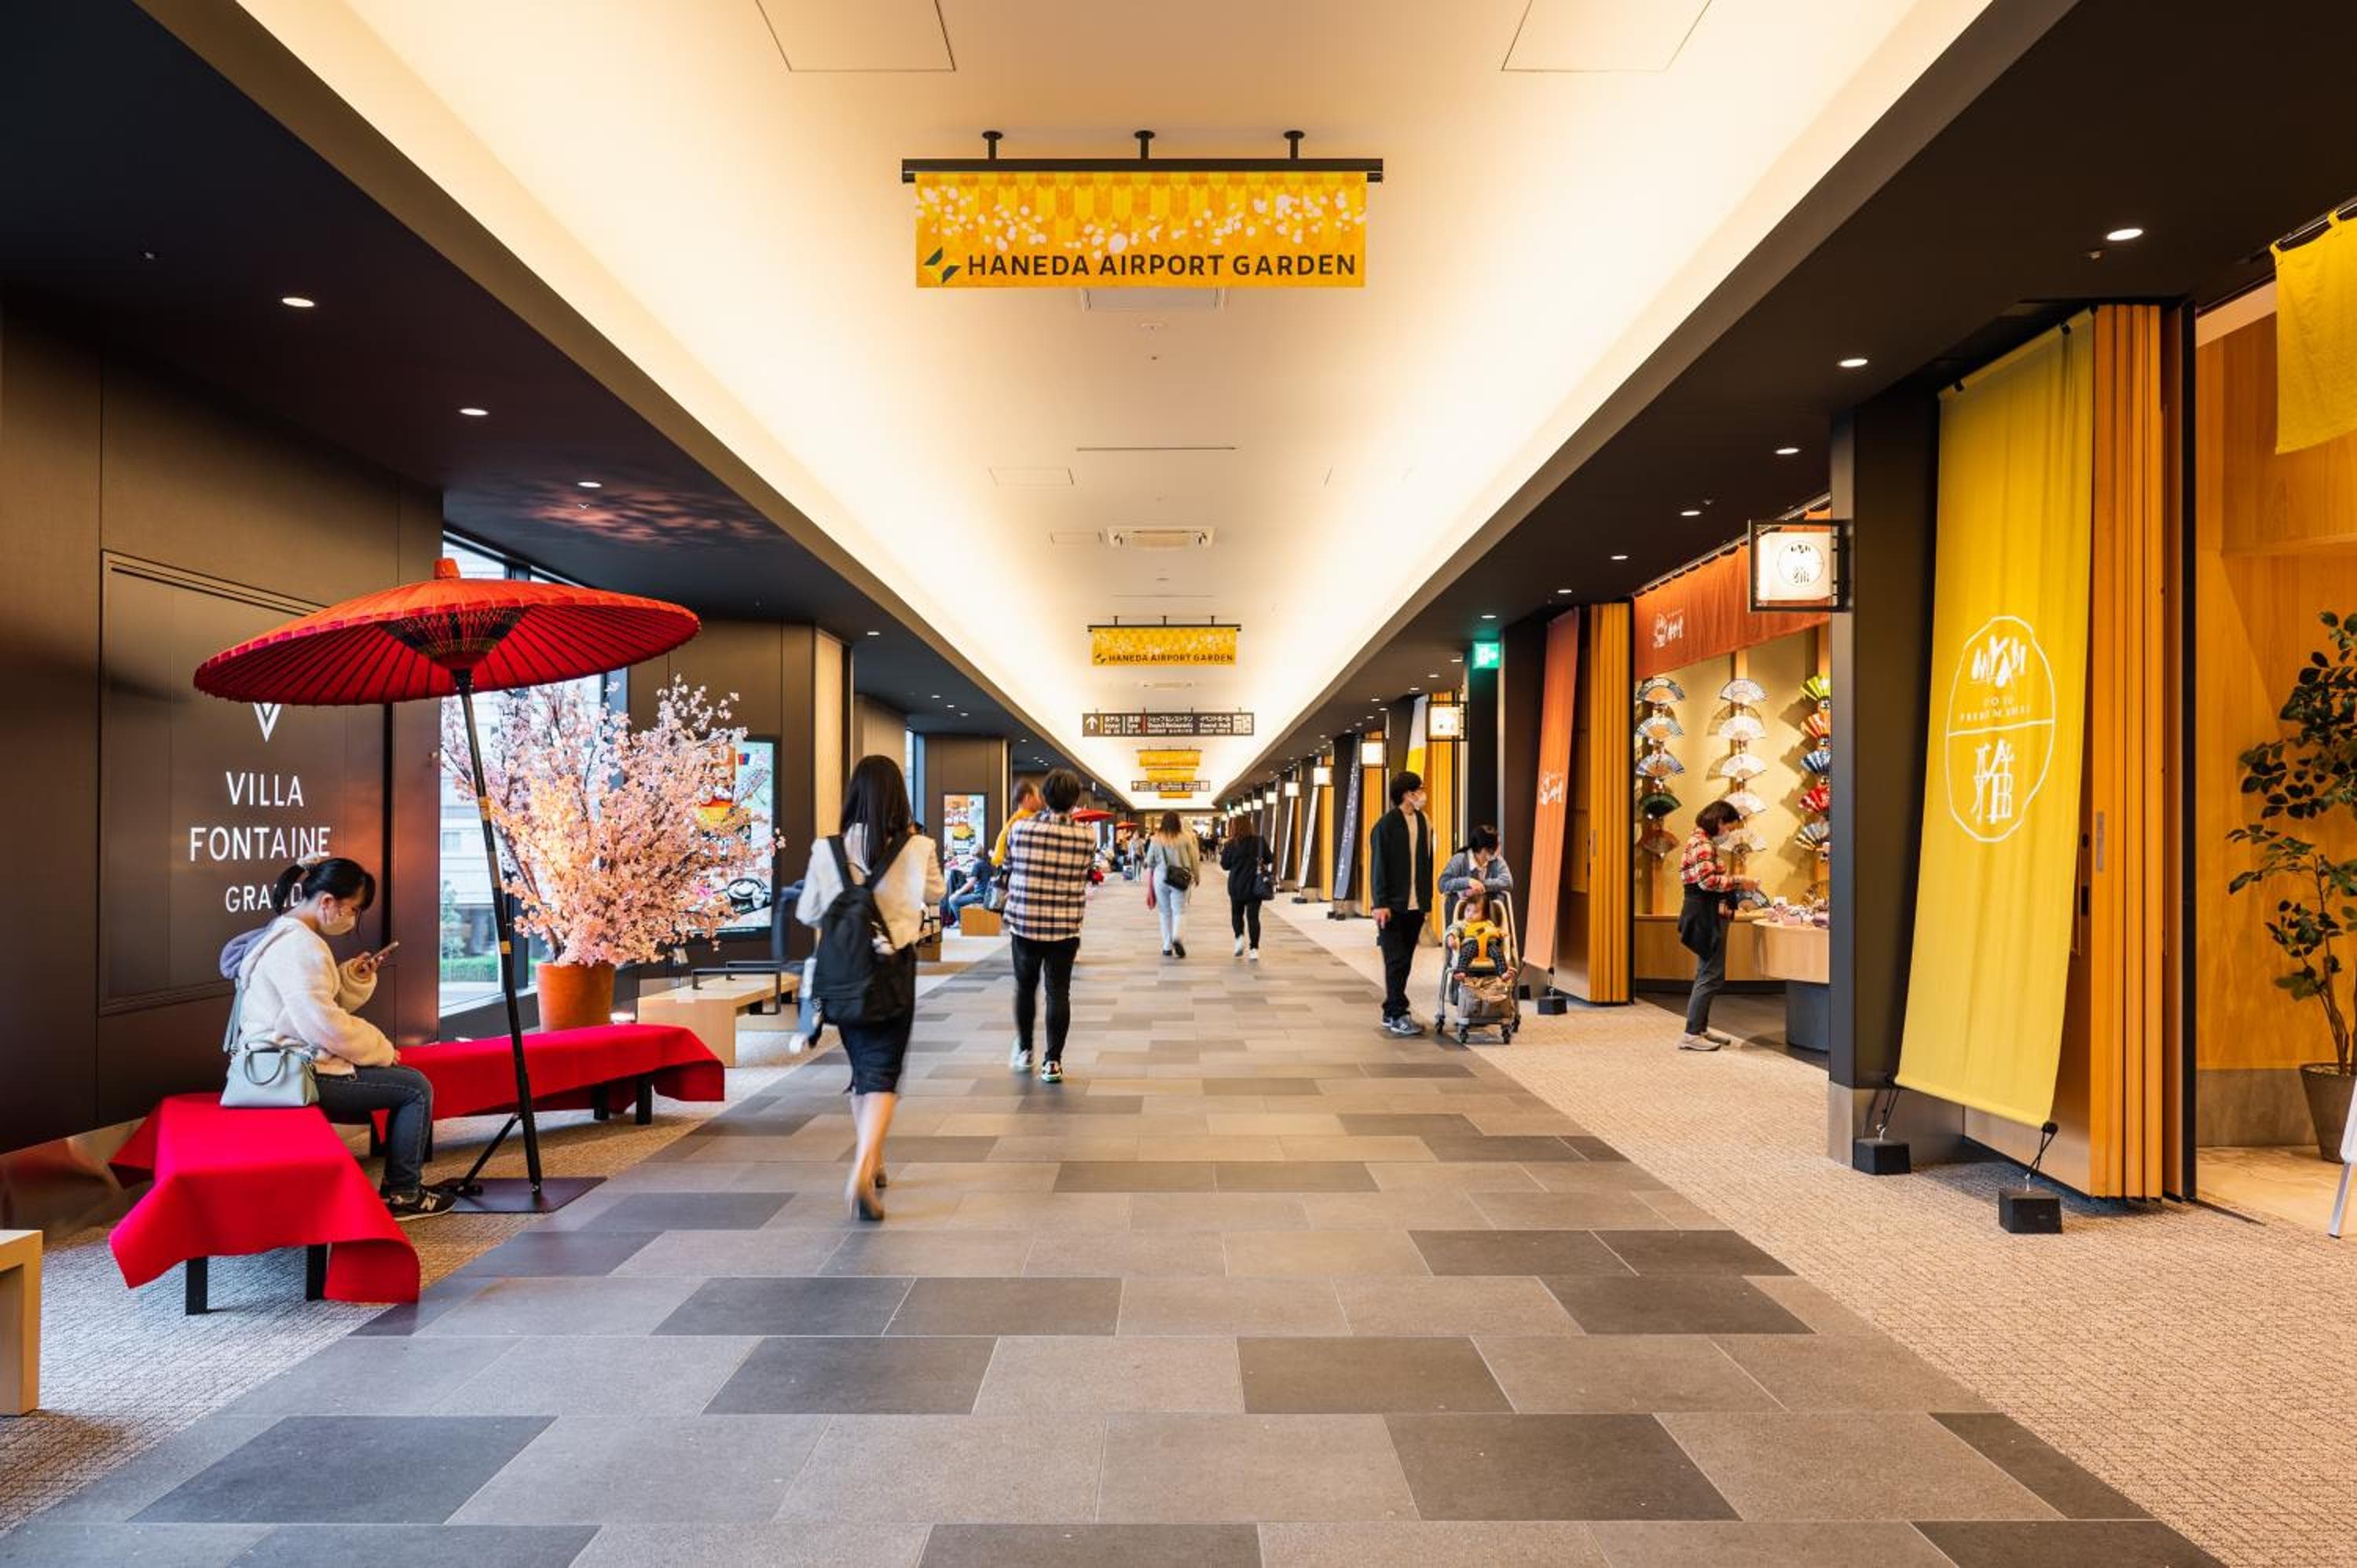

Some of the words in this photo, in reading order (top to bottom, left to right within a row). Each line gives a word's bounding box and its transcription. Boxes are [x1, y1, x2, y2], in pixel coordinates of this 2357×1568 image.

[968, 255, 1089, 276] HANEDA
[1100, 255, 1224, 276] AIRPORT
[1233, 255, 1356, 275] GARDEN
[1109, 654, 1148, 662] HANEDA
[1150, 654, 1191, 662] AIRPORT
[225, 771, 304, 807] VILLA
[189, 827, 331, 862] FONTAINE
[225, 883, 303, 913] GRAD
